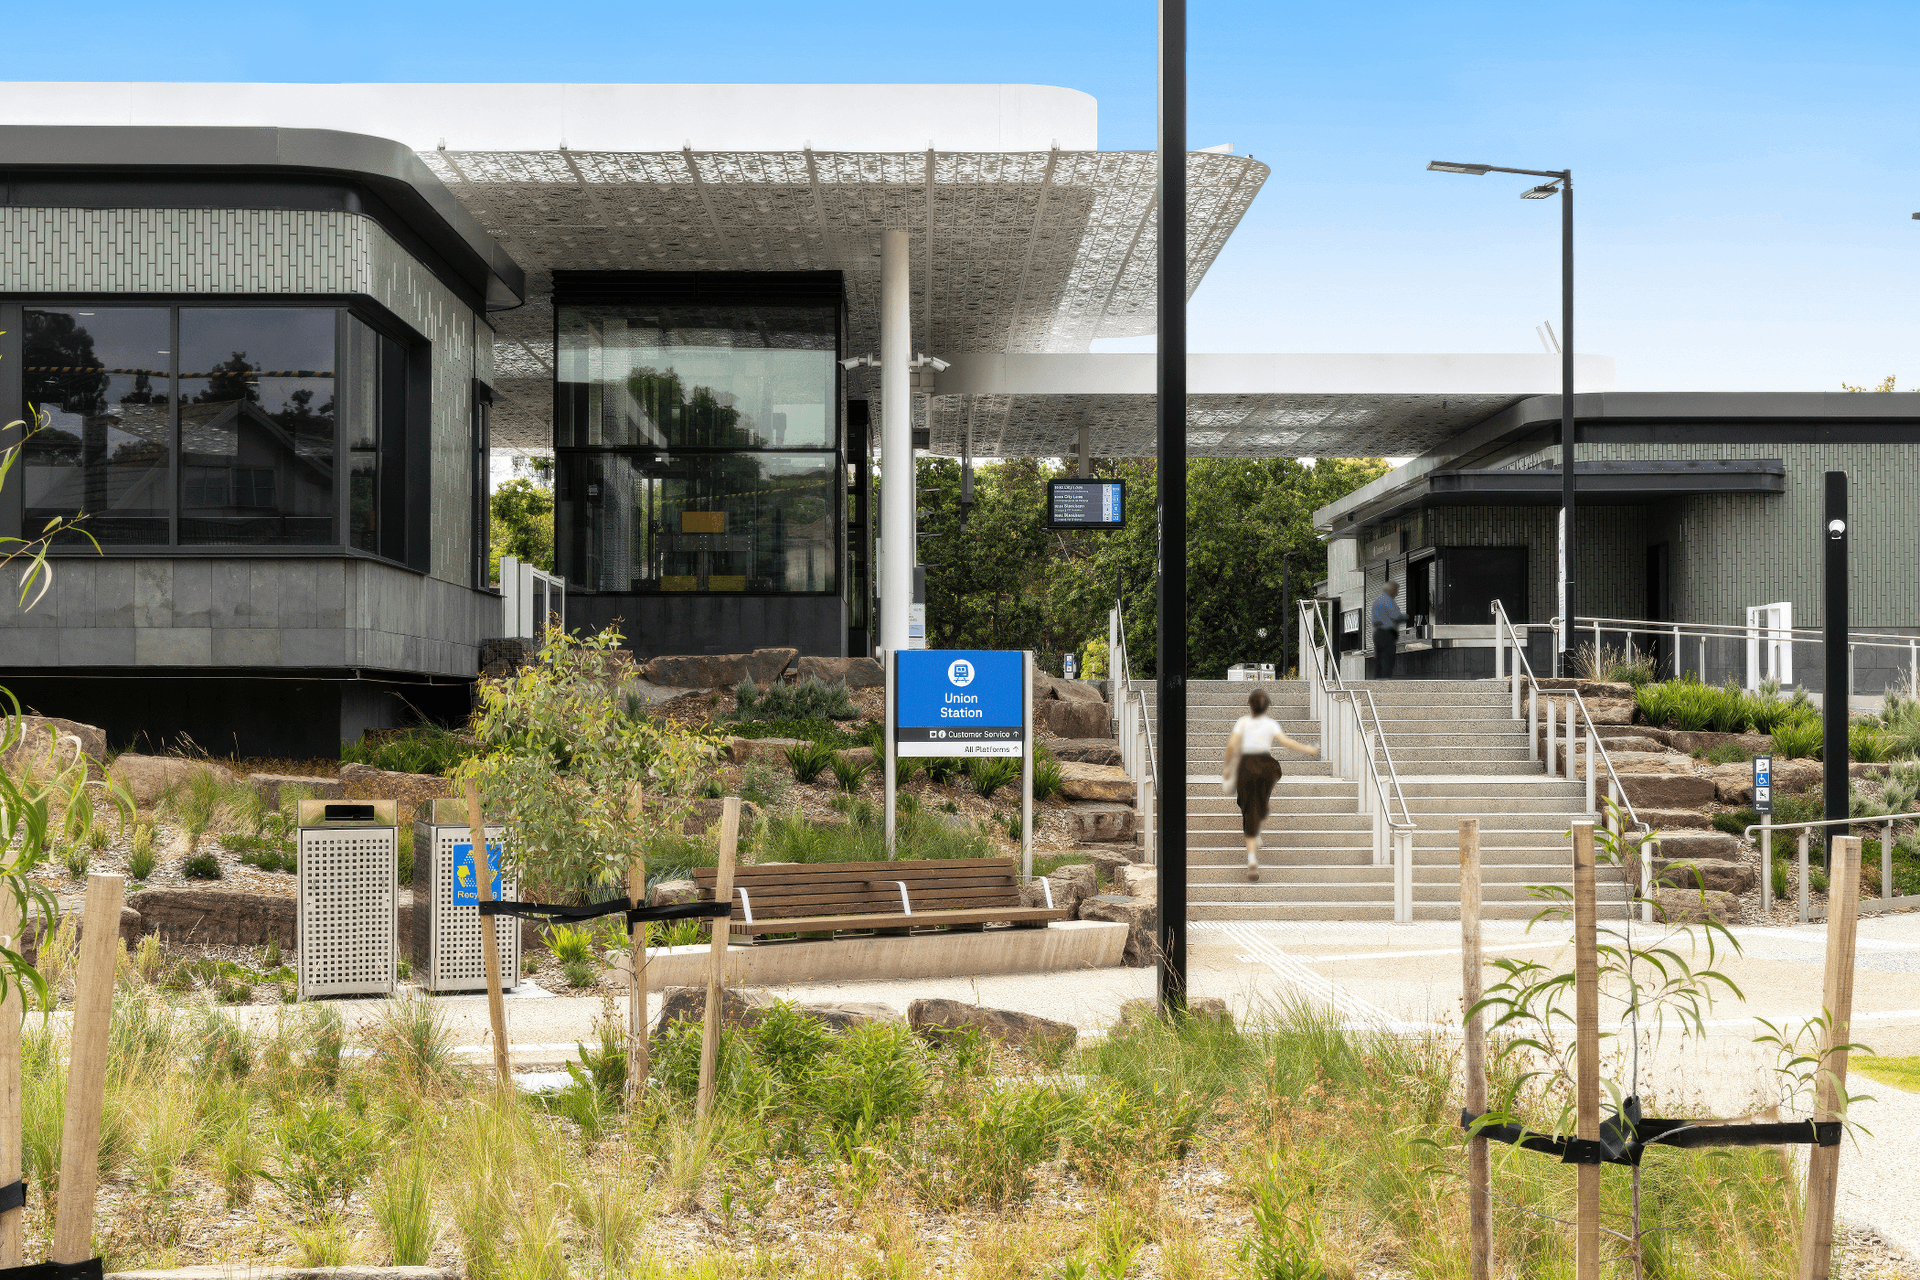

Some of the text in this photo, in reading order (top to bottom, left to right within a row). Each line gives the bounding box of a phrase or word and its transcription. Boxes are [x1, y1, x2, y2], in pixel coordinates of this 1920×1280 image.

[945, 692, 978, 703] Union
[940, 707, 982, 717] Station
[458, 891, 497, 899] Recyg
